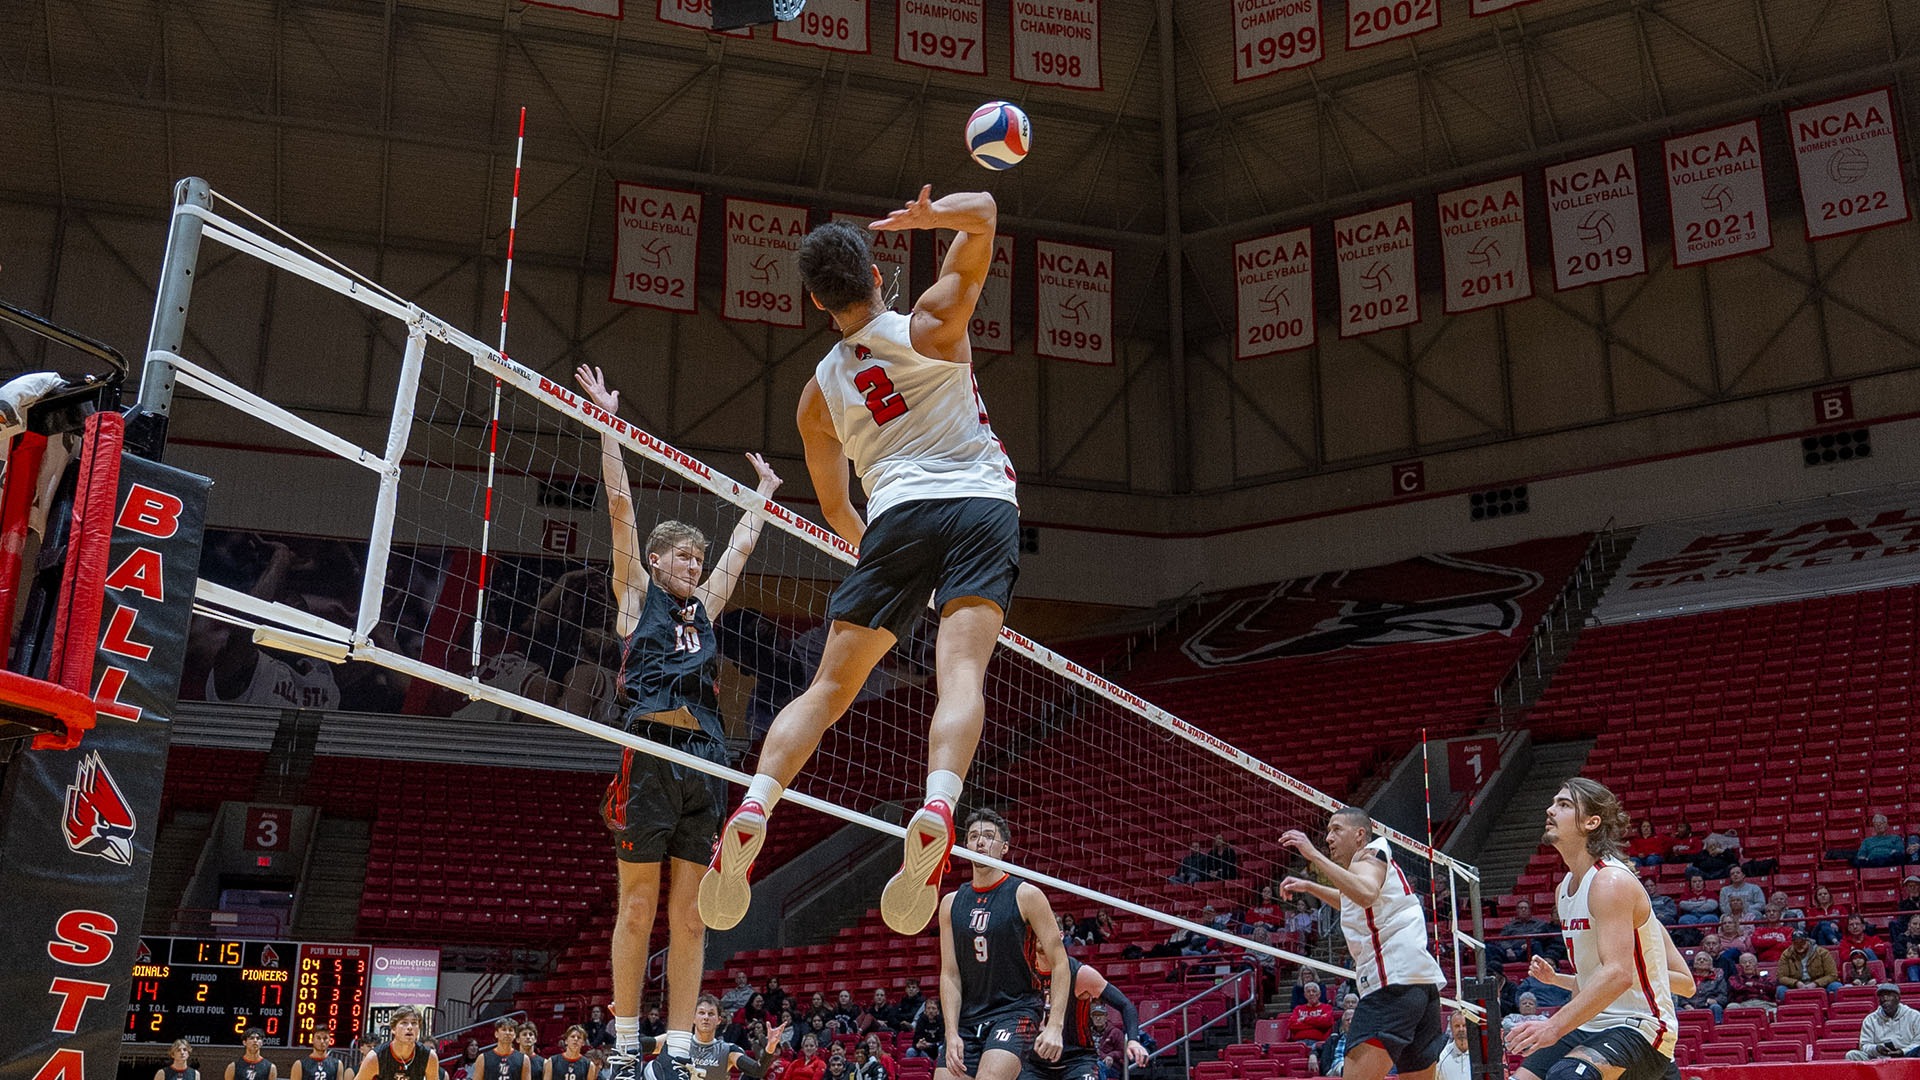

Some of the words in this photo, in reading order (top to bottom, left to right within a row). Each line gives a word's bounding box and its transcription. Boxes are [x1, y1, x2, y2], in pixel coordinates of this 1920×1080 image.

[800, 12, 848, 40] 1996
[906, 2, 978, 24] CHAMPIONS
[1017, 2, 1094, 24] VOLLEYBALL
[1241, 0, 1312, 30] CHAMPIONS
[1354, 0, 1432, 36] 2002
[1020, 19, 1092, 40] CHAMPIONS
[907, 30, 976, 60] 1997
[1240, 27, 1316, 68] 1999
[1032, 51, 1081, 78] 1998
[1799, 106, 1884, 142] NCAA
[1840, 127, 1892, 146] VOLLEYBALL
[1670, 136, 1756, 171] NCAA
[1550, 163, 1632, 197] NCAA
[1672, 159, 1759, 186] VOLLEYBALL
[620, 196, 697, 223] NCAA
[1442, 190, 1520, 223] NCAA
[1552, 186, 1634, 212] VOLLEYBALL
[1821, 192, 1888, 220] 2022
[624, 217, 693, 236] VOLLEYBALL
[728, 211, 802, 237] NCAA
[1337, 216, 1410, 248] NCAA
[1444, 212, 1522, 237] VOLLEYBALL
[1686, 211, 1755, 242] 2021
[732, 234, 800, 251] VOLLEYBALL
[874, 230, 908, 251] AA
[1339, 239, 1412, 262] VOLLEYBALL
[1688, 238, 1725, 252] ROUND
[1728, 235, 1742, 244] OF
[1745, 231, 1757, 242] 32
[872, 251, 905, 264] YBALL
[1040, 252, 1109, 279] NCAA
[1238, 242, 1308, 272] NCAA
[1567, 246, 1632, 276] 2019
[625, 272, 684, 298] 1992
[1040, 274, 1110, 293] VOLLEYBALL
[1240, 263, 1309, 285] VOLLEYBALL
[1461, 270, 1514, 297] 2011
[736, 290, 792, 313] 1993
[1350, 295, 1408, 322] 2002
[973, 319, 1000, 338] 95
[1048, 329, 1101, 350] 1999
[1248, 318, 1302, 344] 2000
[854, 365, 910, 426] 2
[1824, 398, 1844, 420] B
[538, 376, 577, 408] BALL
[582, 400, 627, 434] STATE
[630, 426, 711, 481] VOLLEYBALL
[1400, 472, 1418, 491] C
[764, 500, 792, 524] BALL
[795, 516, 830, 543] STATE
[551, 530, 569, 549] E
[92, 482, 184, 722] BALL
[675, 624, 701, 653] 10
[1066, 661, 1084, 678] BALL
[1086, 673, 1107, 690] STATE
[1108, 683, 1147, 711] VOLLEYBALL
[1172, 718, 1187, 732] BALL
[1187, 725, 1205, 741] STATE
[1206, 735, 1238, 758] VOLLEYBALL
[1466, 753, 1482, 784] 1
[256, 820, 278, 847] 3
[968, 908, 991, 934] TU
[198, 943, 239, 965] 1:15
[973, 936, 989, 963] 9
[132, 966, 169, 978] DINALS
[242, 969, 288, 982] PIONEERS
[303, 958, 320, 970] 04
[335, 959, 342, 972] 5
[358, 960, 365, 972] 3
[390, 958, 436, 968] minnetrista
[191, 973, 217, 982] PERIOD
[301, 973, 318, 985] 05
[335, 974, 341, 985] 7
[360, 976, 363, 986] 1
[137, 981, 158, 1000] 14
[197, 984, 208, 1002] 2
[261, 984, 282, 1005] 17
[299, 988, 317, 1000] 07
[333, 989, 339, 1001] 3
[354, 990, 362, 1002] 2
[177, 1005, 205, 1014] PLAYER
[206, 1006, 225, 1015] FOUL
[260, 1008, 283, 1016] FOULS
[298, 1002, 316, 1015] 09
[330, 1004, 338, 1016] 0
[353, 1004, 360, 1016] 0
[151, 1014, 163, 1031] 2
[235, 1016, 246, 1034] 2
[266, 1017, 279, 1035] 0
[301, 1017, 314, 1030] 10
[329, 1019, 336, 1030] 0
[352, 1019, 359, 1031] 3
[995, 1028, 1013, 1042] TU
[184, 1035, 210, 1044] MATCH
